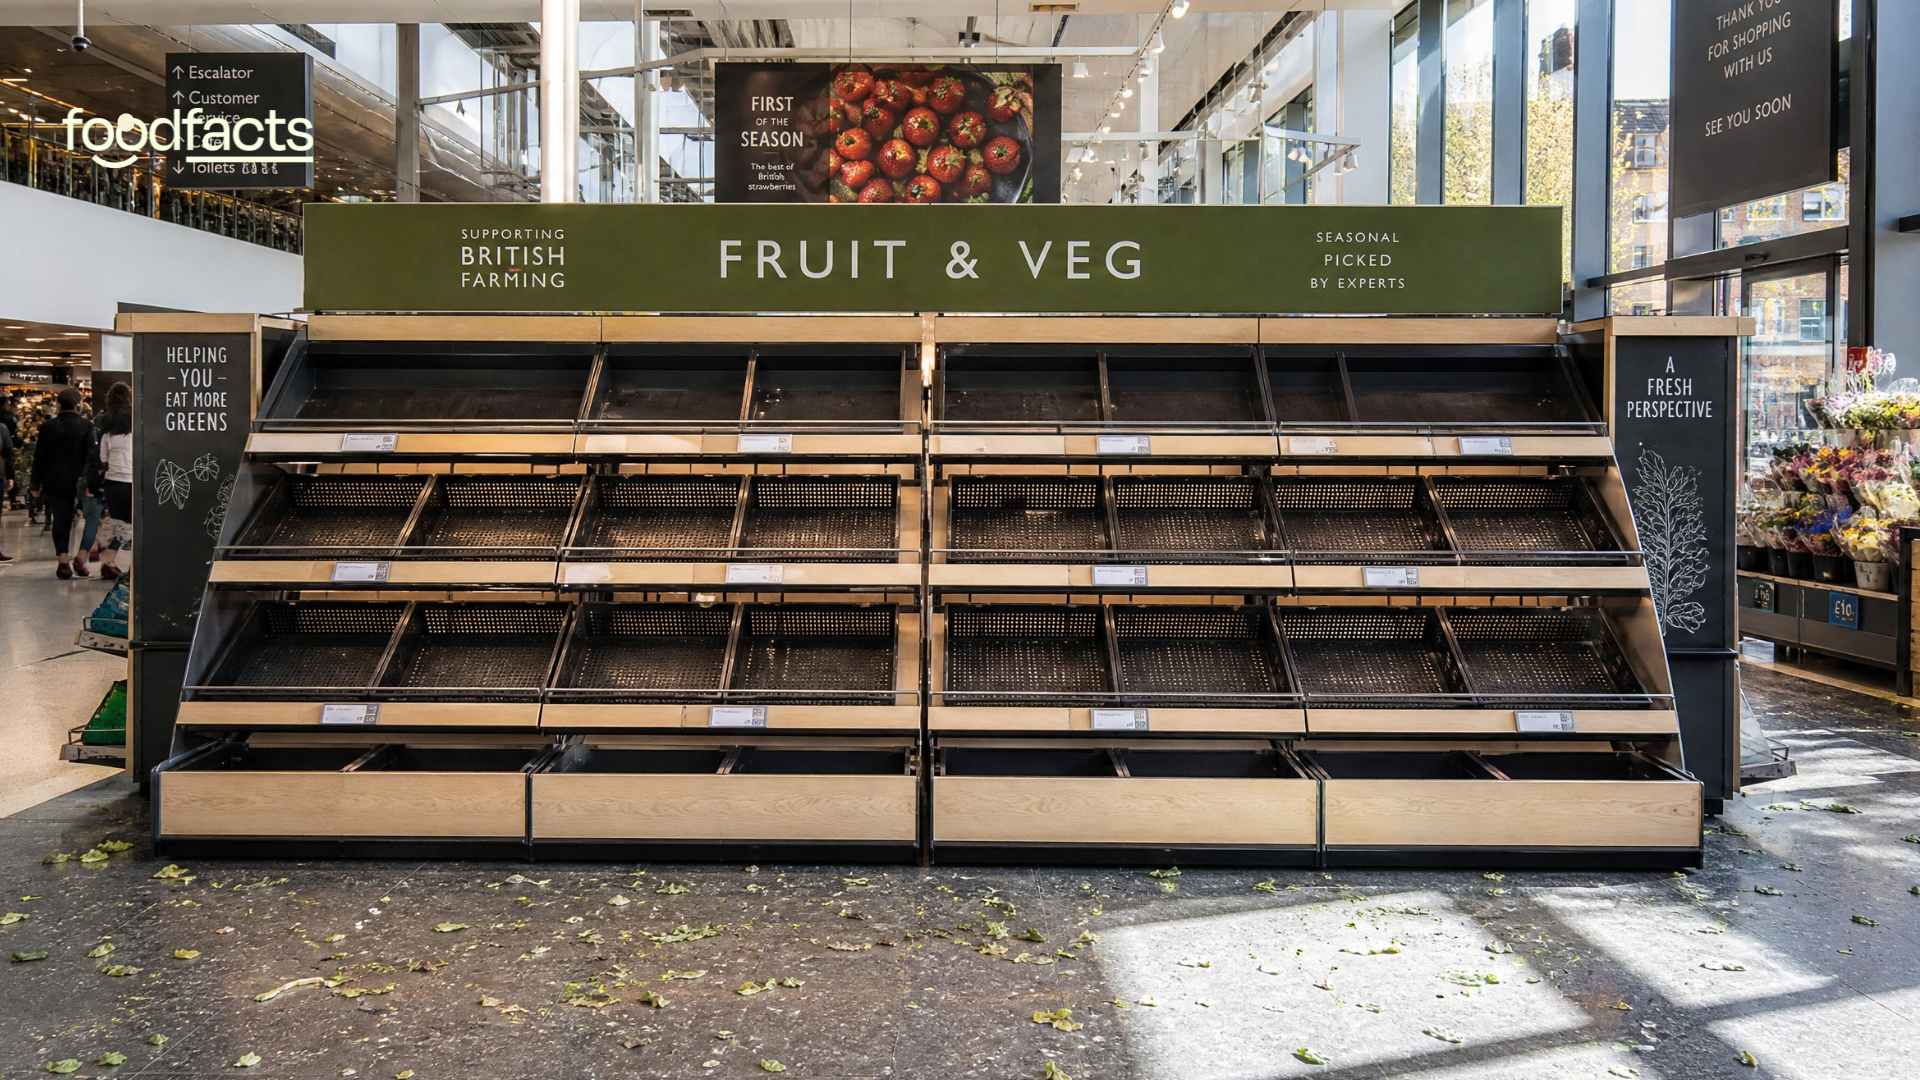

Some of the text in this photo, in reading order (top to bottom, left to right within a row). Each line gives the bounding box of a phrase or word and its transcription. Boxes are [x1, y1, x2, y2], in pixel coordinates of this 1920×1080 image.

[1716, 0, 1782, 31] THANK YO
[1708, 11, 1792, 62] FOR SHOPPING
[1723, 46, 1773, 79] WITH US
[188, 65, 254, 80] Escalator
[188, 90, 260, 105] Customer
[751, 96, 794, 112] FIRST
[755, 118, 789, 126] OF THE
[1705, 93, 1792, 137] SEE YOU SOON
[740, 131, 804, 147] SEASON
[191, 160, 236, 174] Toilets
[751, 162, 794, 171] The best of
[461, 229, 565, 240] SUPPORTING
[1316, 231, 1400, 243] SEASONAL
[461, 246, 565, 266] BRITISH
[720, 240, 1142, 280] FRUIT & VEG
[1324, 254, 1392, 267] PICKED
[461, 272, 565, 288] FARMING
[1310, 278, 1405, 289] BY EXPERTS
[166, 346, 228, 364] HELPING
[1665, 355, 1676, 374] A
[1647, 377, 1693, 397] FRESH
[165, 391, 228, 408] EAT MORE
[1627, 400, 1713, 418] PERSPECTIVE
[165, 412, 228, 432] GREENS
